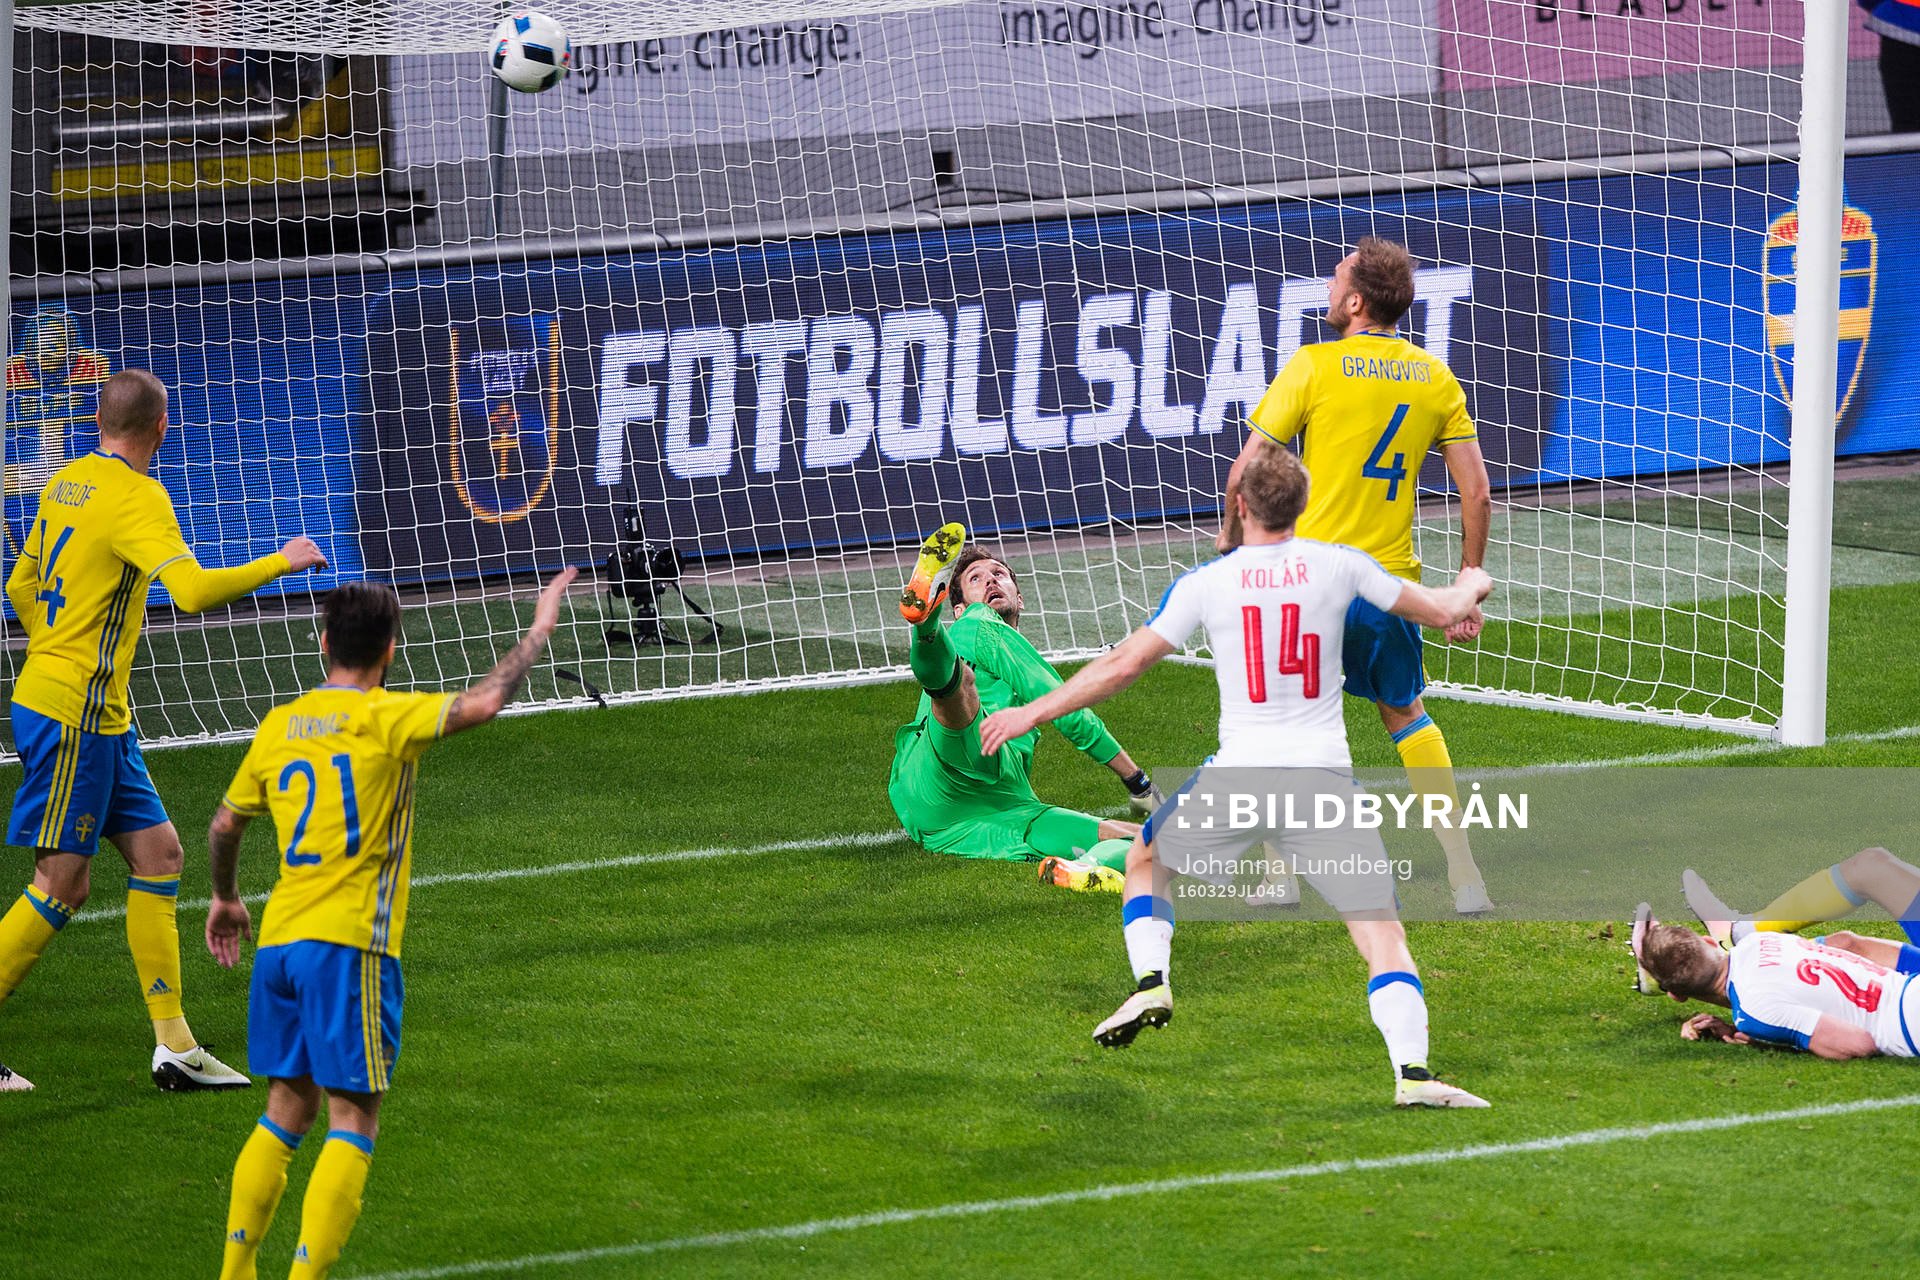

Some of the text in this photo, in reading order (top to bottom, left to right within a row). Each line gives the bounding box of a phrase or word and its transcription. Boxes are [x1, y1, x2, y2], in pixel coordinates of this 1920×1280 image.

[564, 24, 861, 94] gine. change.
[1001, 0, 1352, 59] imagine. change.
[595, 267, 1472, 485] FOTBOLLSLAT
[1342, 356, 1431, 384] GRANQVIST
[1362, 403, 1410, 501] 4
[1242, 603, 1320, 703] 14
[278, 753, 361, 866] 21
